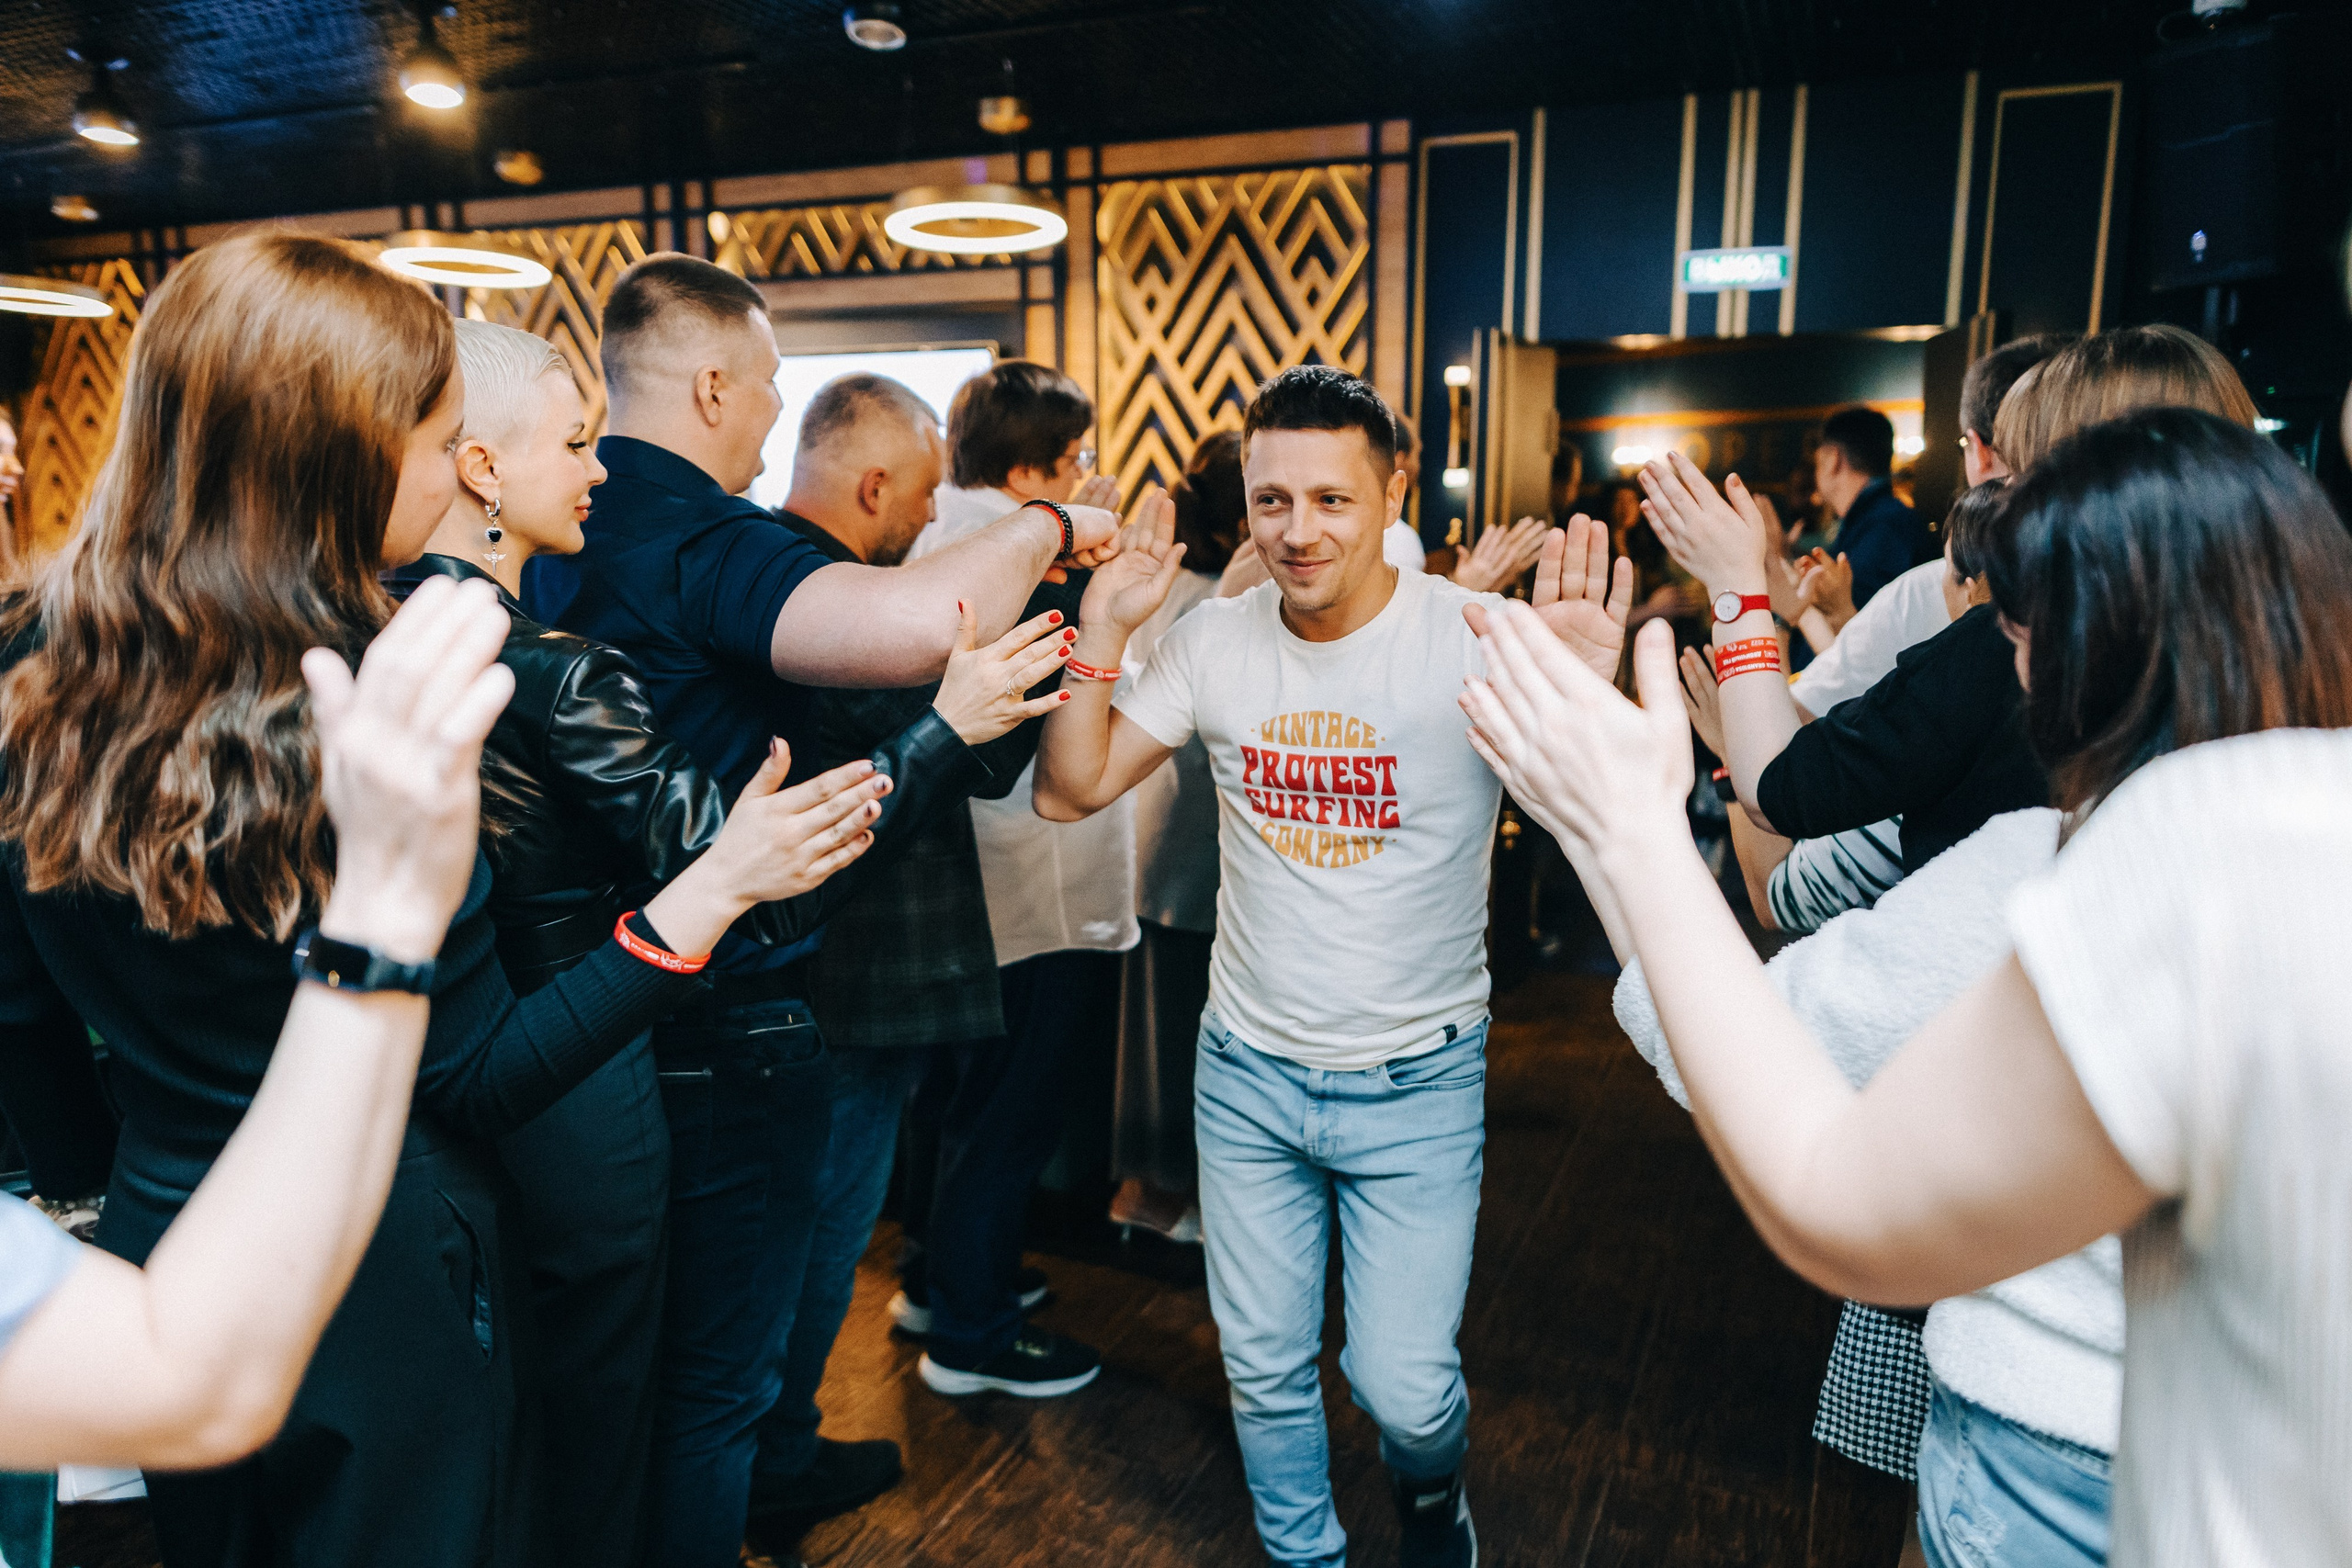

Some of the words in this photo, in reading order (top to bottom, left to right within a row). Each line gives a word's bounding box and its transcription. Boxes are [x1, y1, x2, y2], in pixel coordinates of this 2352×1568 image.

[1261, 710, 1376, 749] VINTAGE
[1240, 745, 1397, 796] PROTEST
[1244, 787, 1401, 829] SURFING
[1260, 821, 1385, 869] COMPANY
